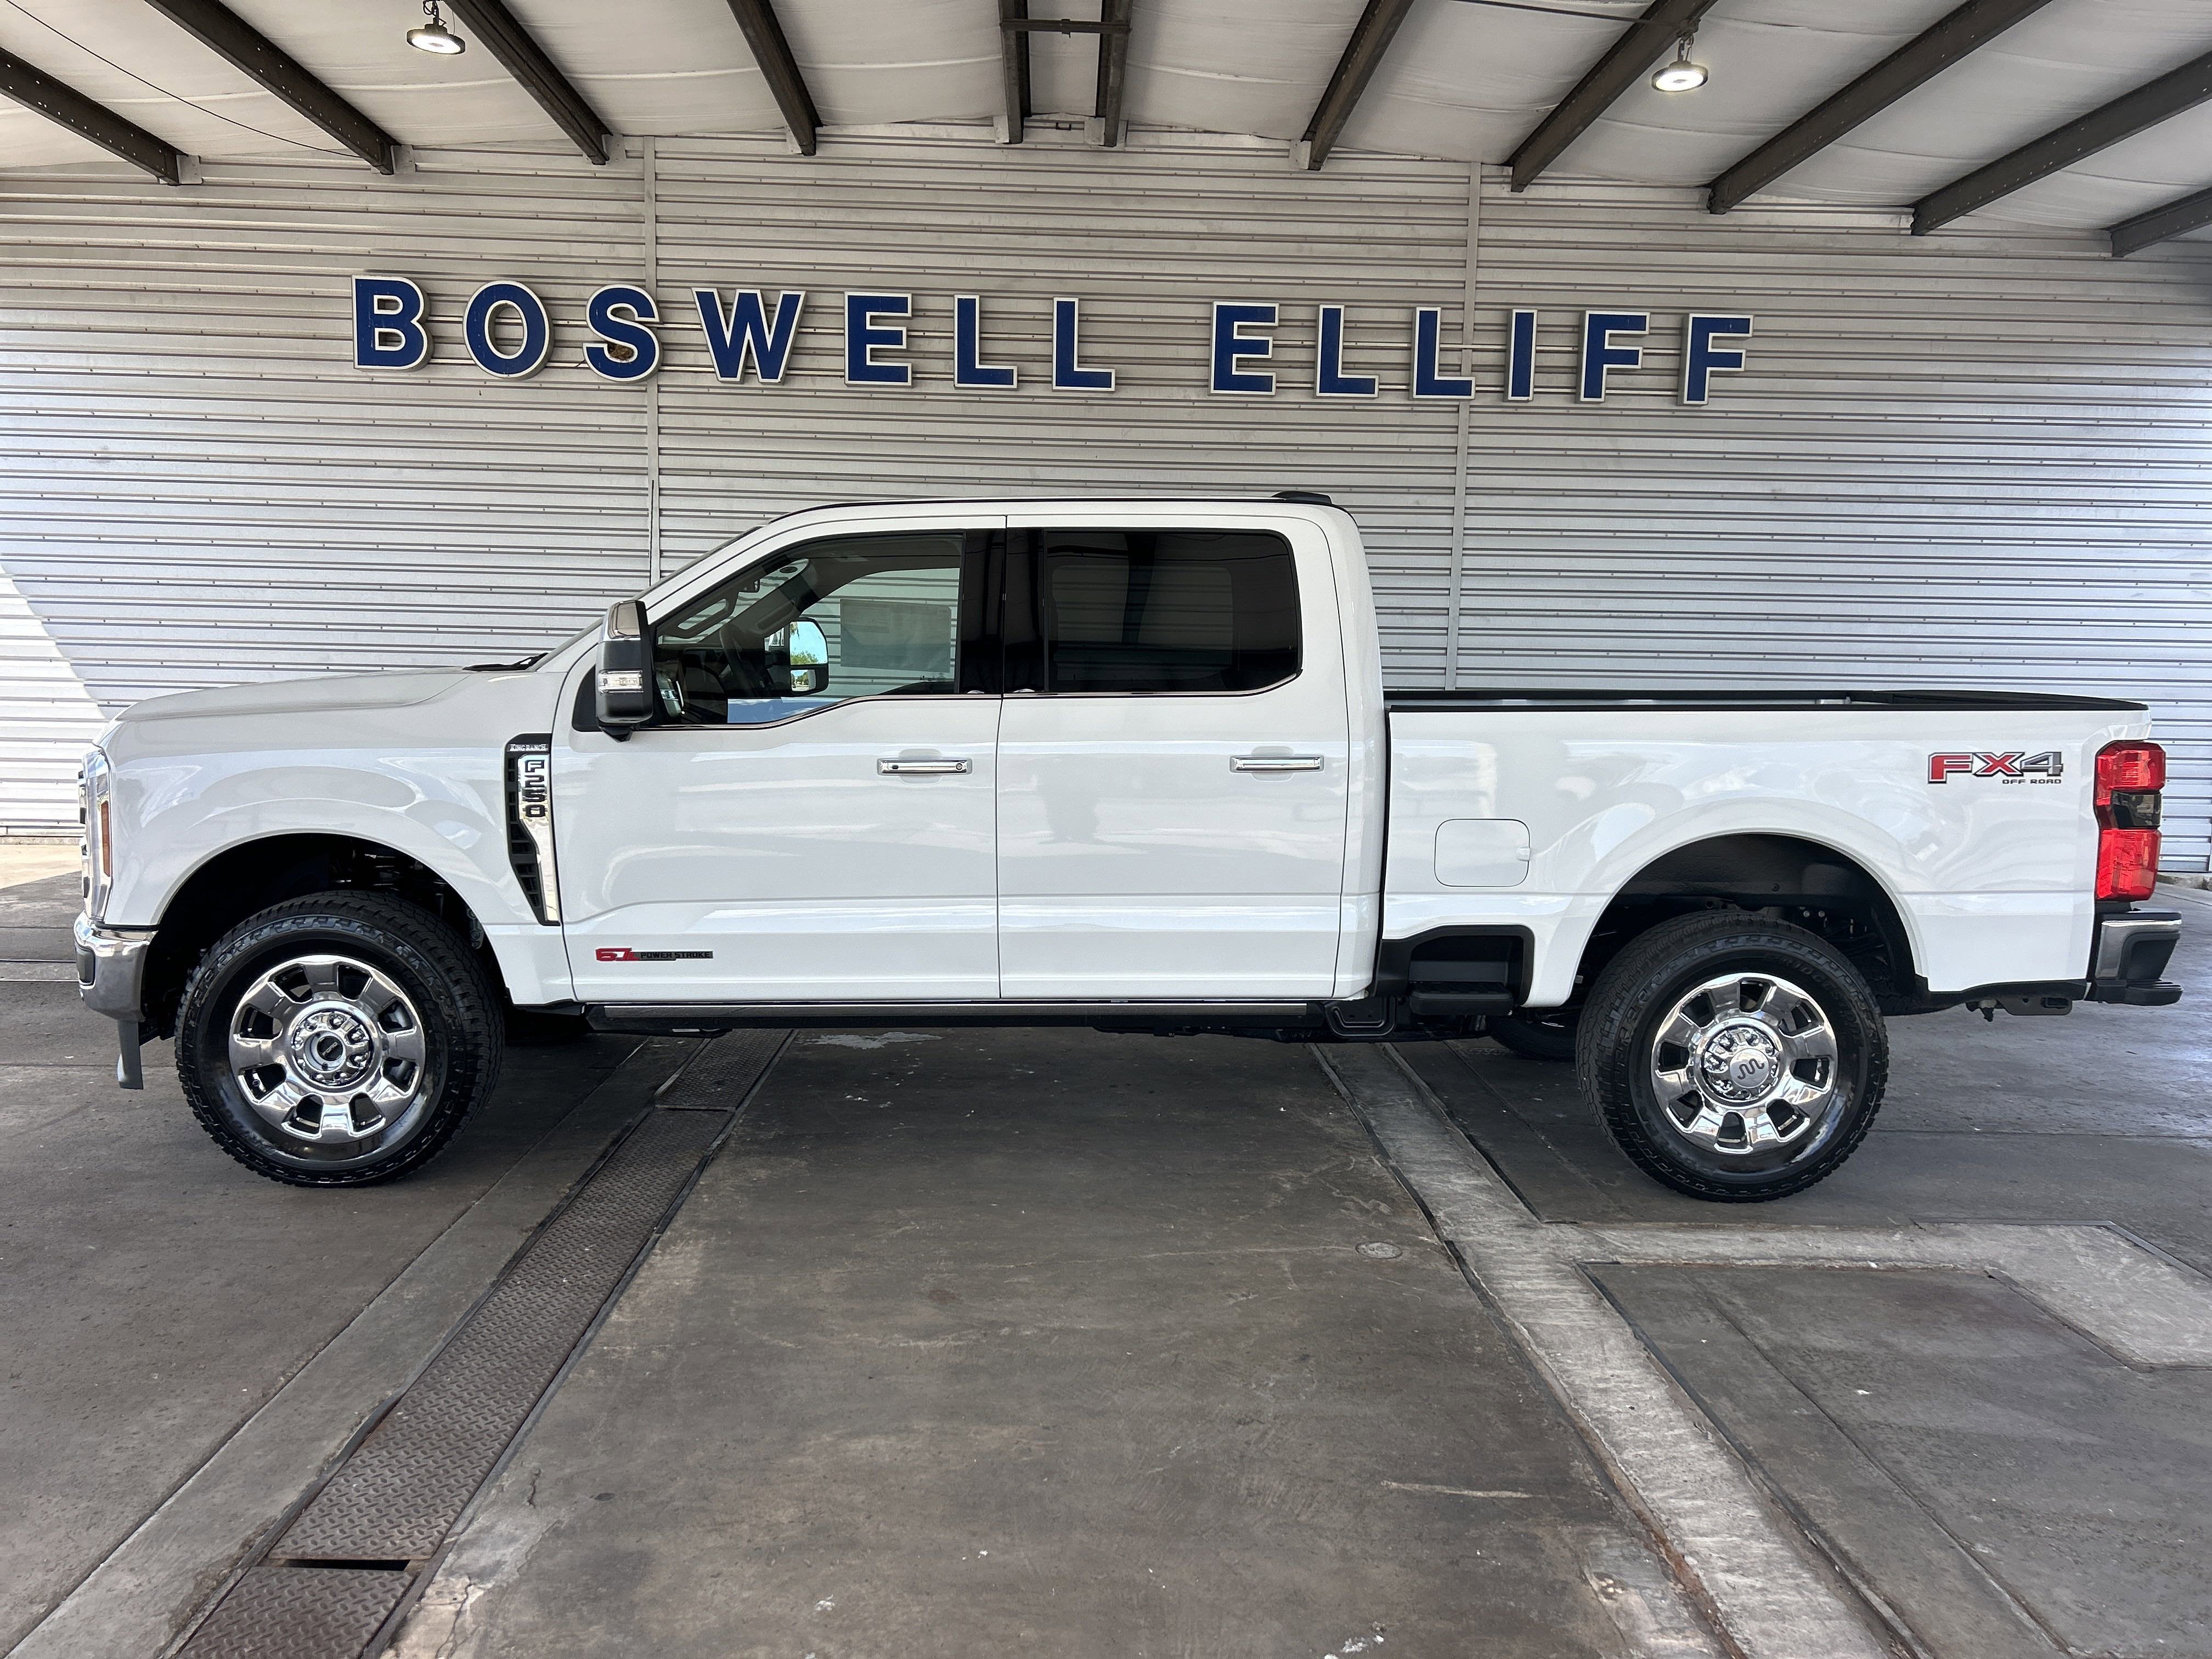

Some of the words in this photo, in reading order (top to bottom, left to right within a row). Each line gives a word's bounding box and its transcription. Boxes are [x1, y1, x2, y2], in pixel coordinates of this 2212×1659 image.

[351, 274, 1116, 391] BOSWELL
[1209, 301, 1754, 405] ELLIFF
[524, 759, 546, 818] F250
[1928, 752, 2064, 784] FX4
